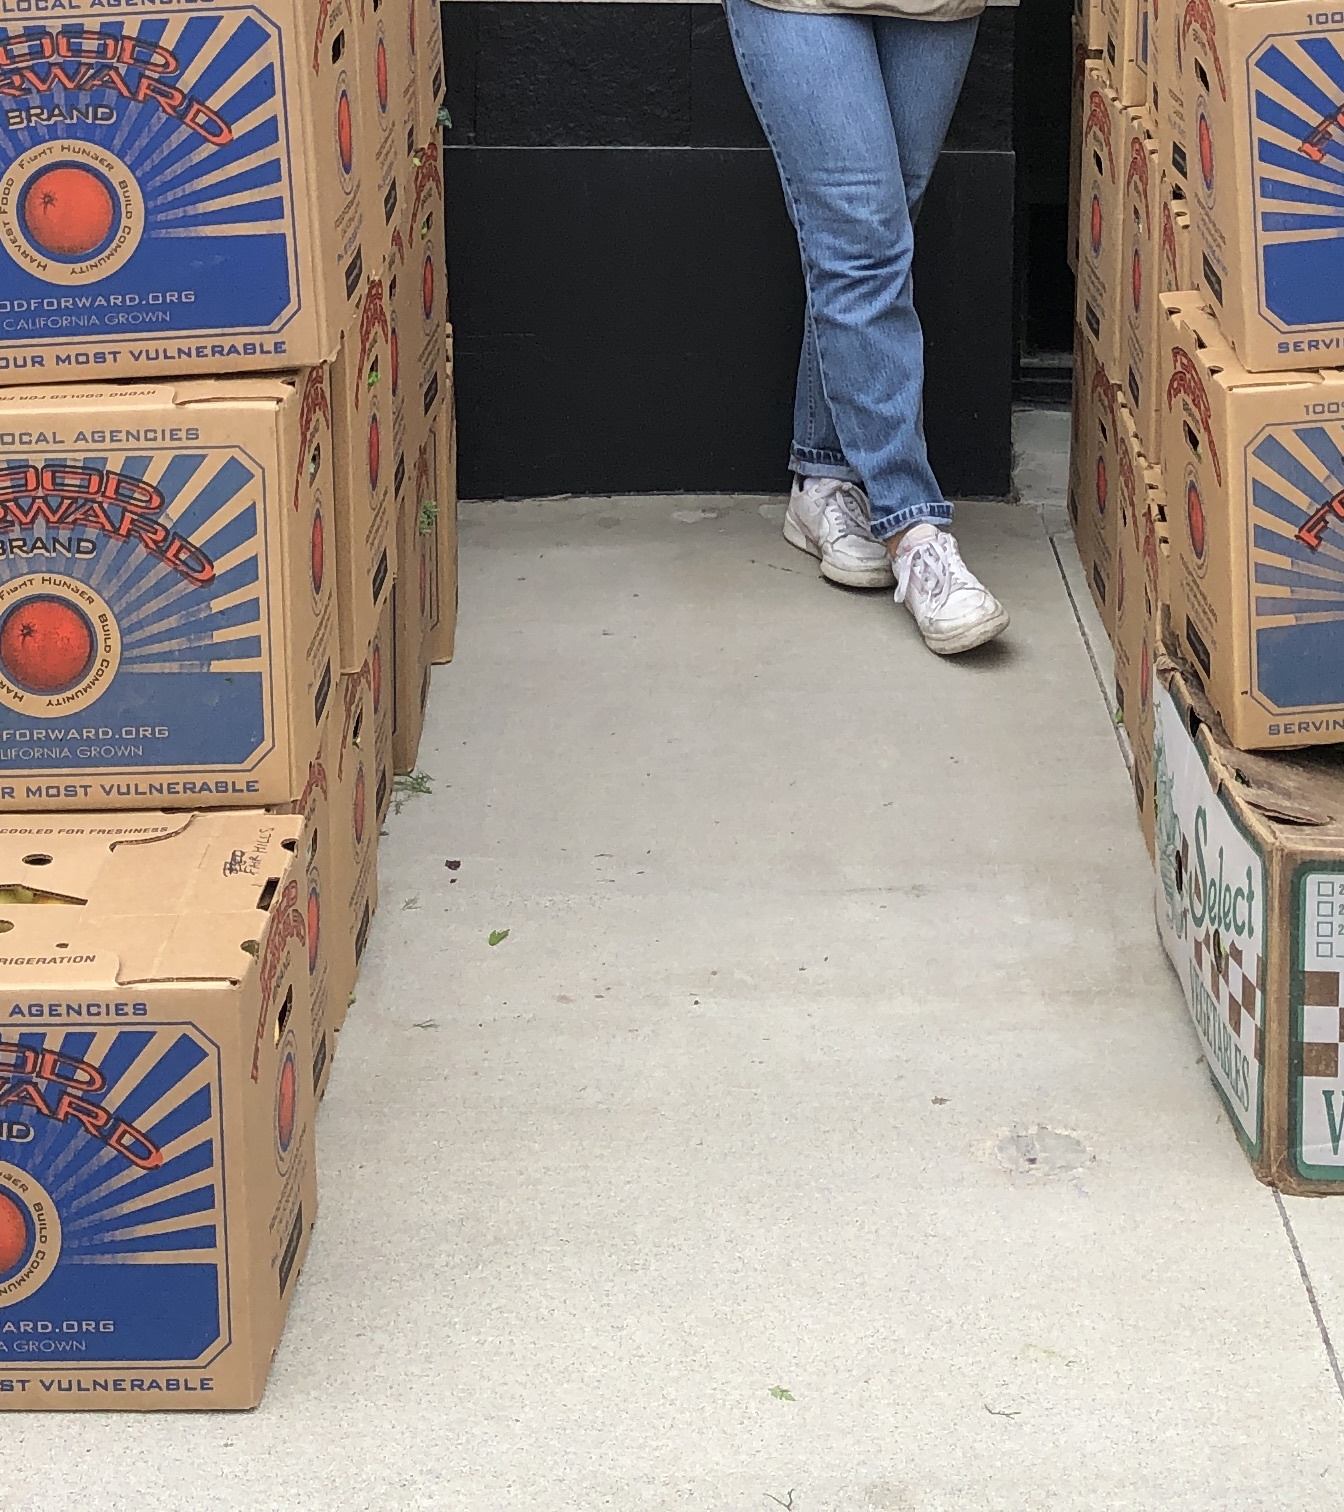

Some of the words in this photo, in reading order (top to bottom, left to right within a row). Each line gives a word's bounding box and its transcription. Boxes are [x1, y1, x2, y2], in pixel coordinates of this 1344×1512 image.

[6, 104, 117, 130] BRAND
[57, 826, 84, 834] FOR
[89, 826, 168, 834] FRESHNESS
[1189, 805, 1255, 939] Select
[1338, 924, 1344, 936] 2
[40, 1378, 214, 1392] VULNERABLE
